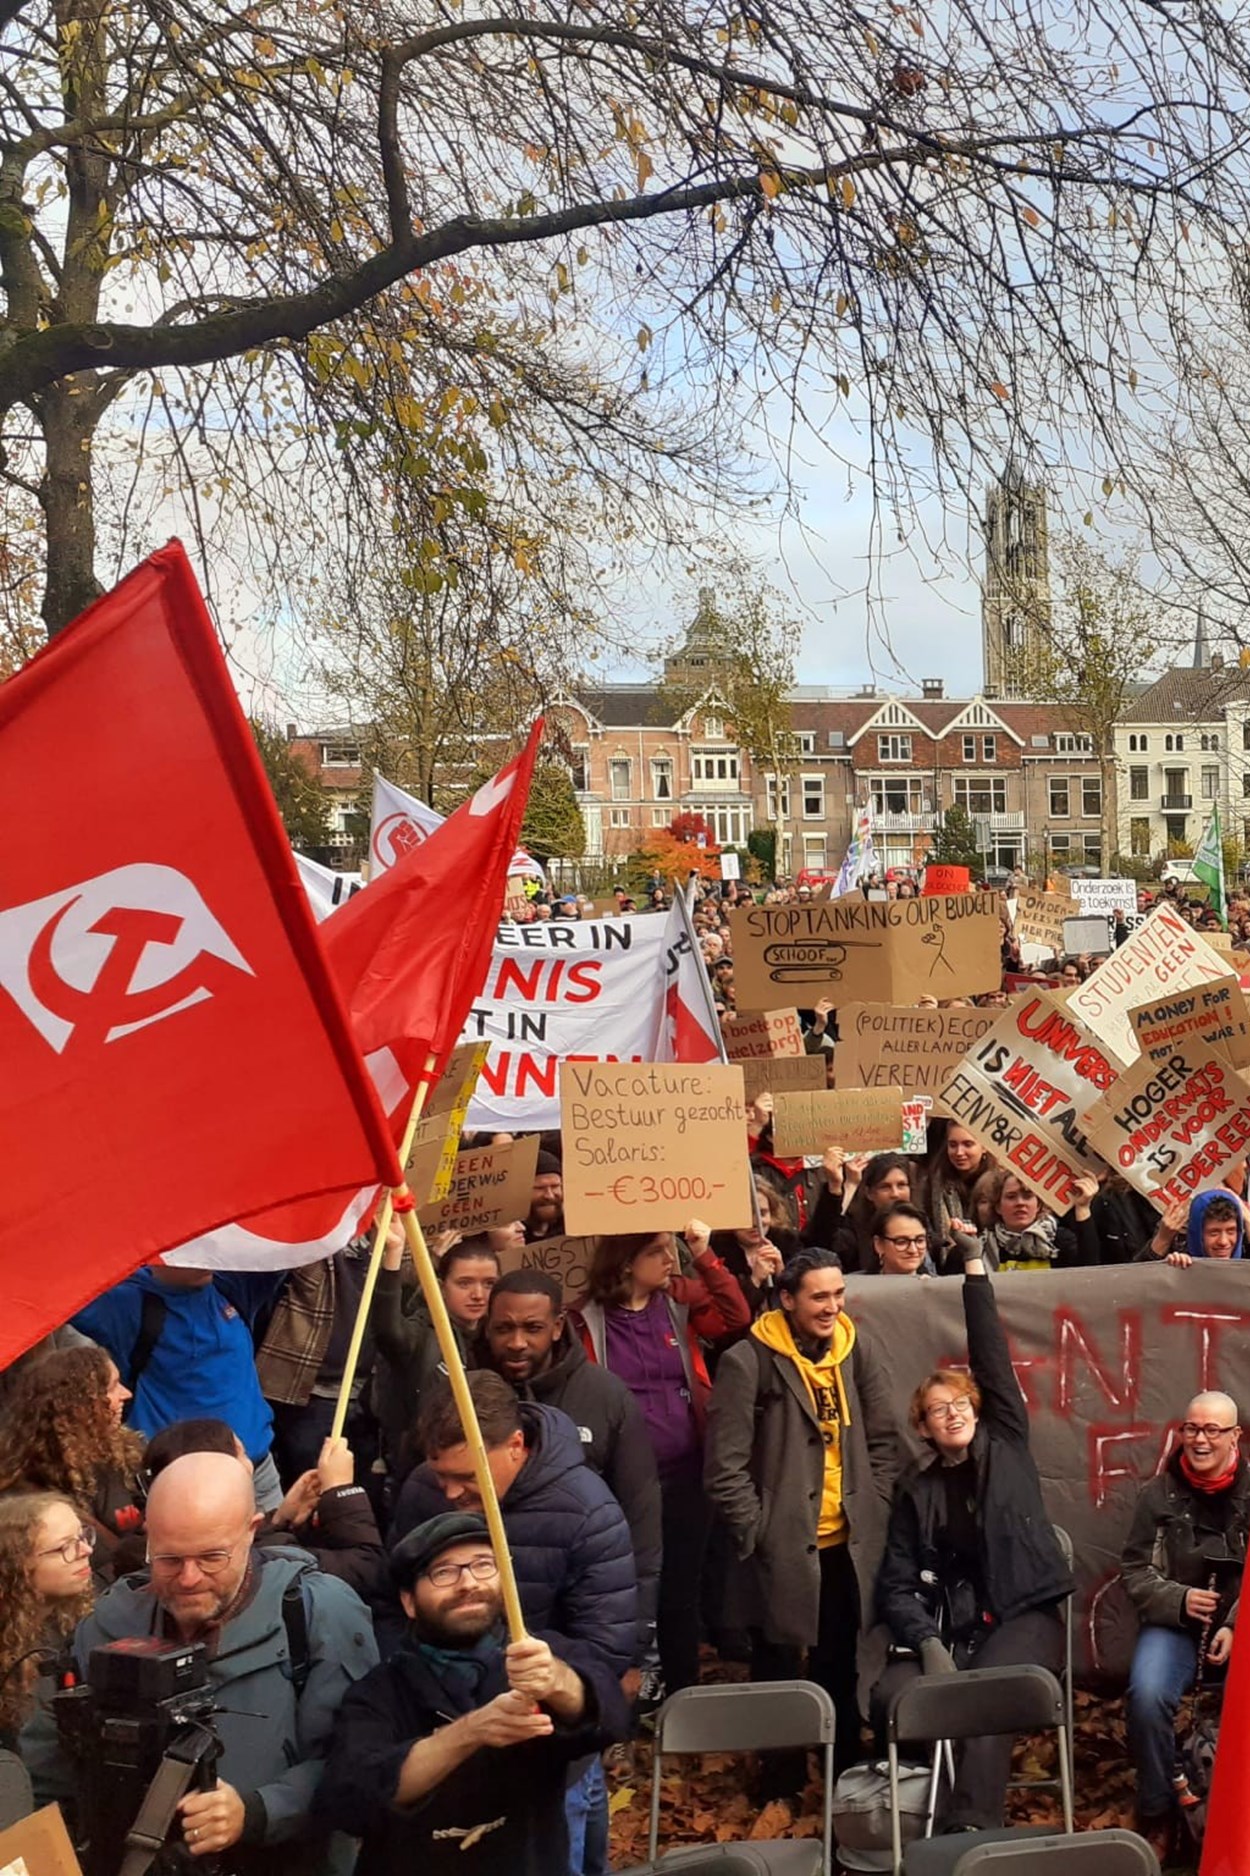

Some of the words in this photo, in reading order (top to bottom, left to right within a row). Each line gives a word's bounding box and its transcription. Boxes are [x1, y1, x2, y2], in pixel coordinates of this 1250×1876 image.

[1071, 880, 1124, 895] Onderzoek
[1088, 896, 1136, 909] toekomst
[906, 899, 940, 926] OUR
[945, 891, 998, 921] BUDGET
[497, 926, 576, 949] EER
[591, 924, 631, 950] IN
[1077, 906, 1187, 1018] STUDENTEN
[1154, 939, 1196, 983] GEEN
[490, 958, 603, 1002] NIS
[507, 1012, 547, 1041] IN
[773, 1014, 796, 1034] op
[1201, 1025, 1235, 1044] WAR
[921, 1040, 974, 1054] LANDE
[977, 1038, 1011, 1074] IS
[571, 1068, 713, 1097] Vacature:
[1113, 1053, 1194, 1134] HOGER
[571, 1103, 665, 1131] Bestuur
[674, 1096, 744, 1134] gezocht
[1118, 1059, 1226, 1168] ONDERWIJS
[938, 1073, 983, 1126] EEN
[1006, 1132, 1083, 1206] ELITE
[1146, 1143, 1177, 1174] IS
[1170, 1086, 1235, 1146] VOOR
[450, 1155, 493, 1172] EEN
[575, 1136, 665, 1167] Salaris:
[447, 1170, 508, 1196] DERWIJS
[440, 1196, 484, 1218] GEEN
